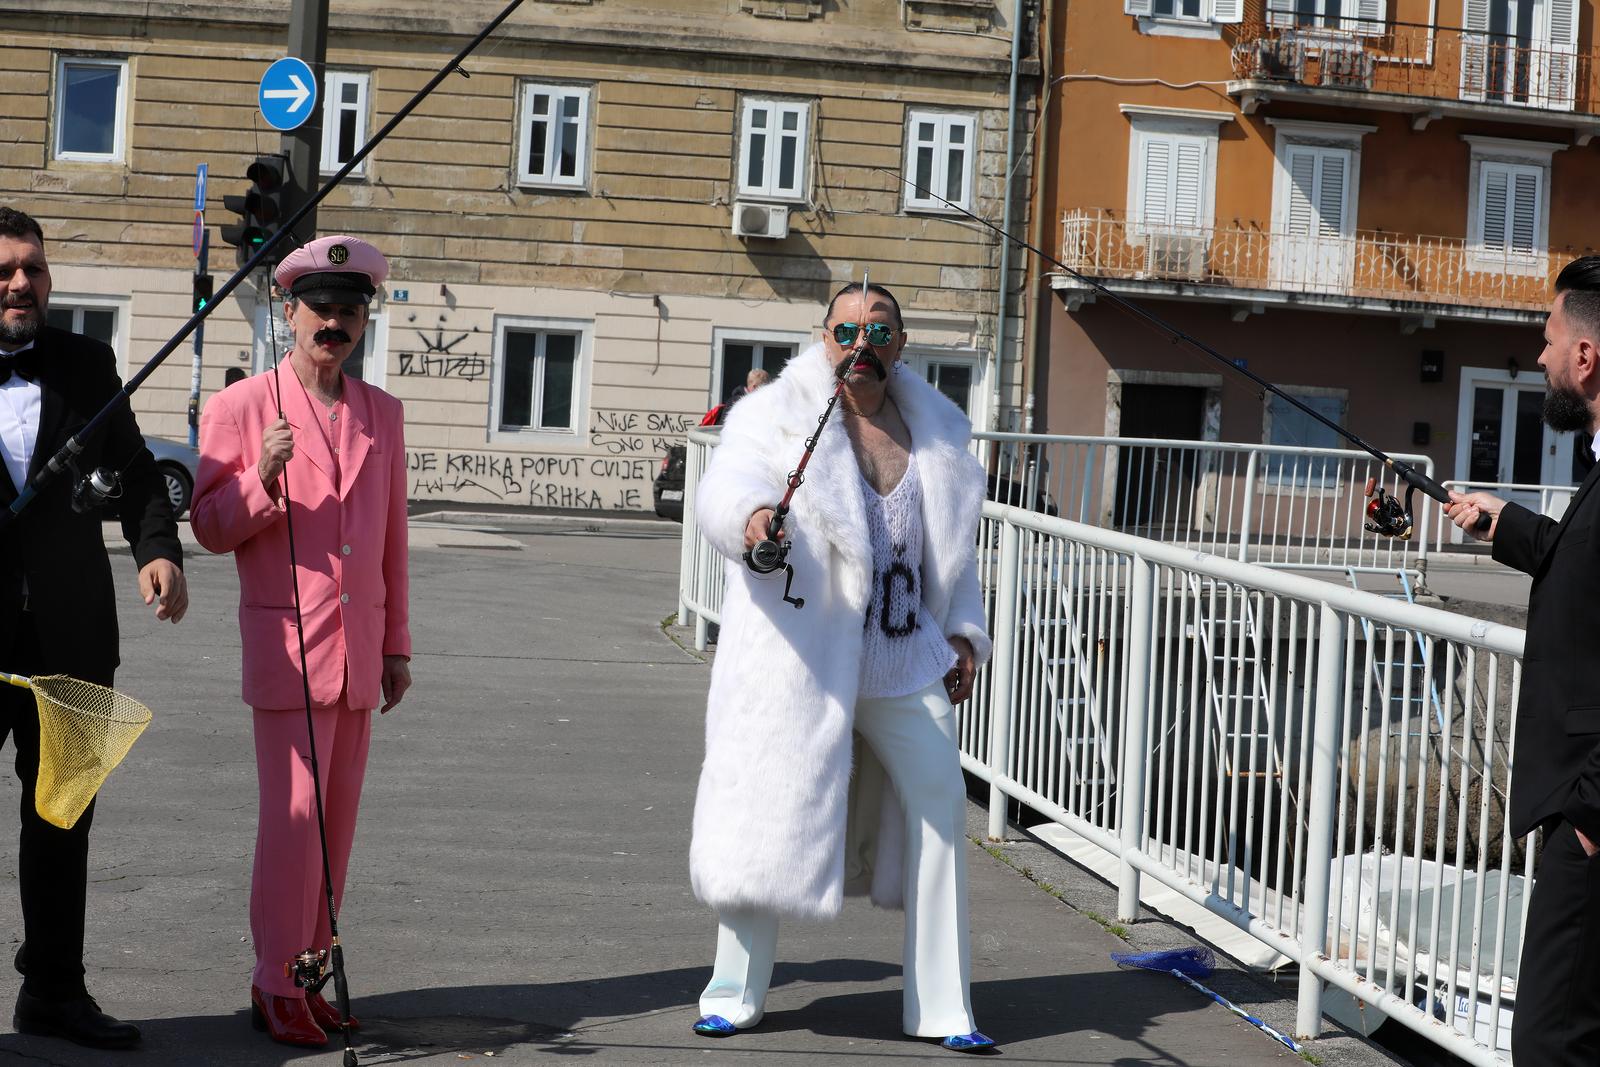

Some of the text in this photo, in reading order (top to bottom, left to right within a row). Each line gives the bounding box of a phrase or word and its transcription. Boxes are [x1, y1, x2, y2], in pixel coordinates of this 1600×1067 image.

[445, 453, 513, 478] KRHKA
[521, 457, 584, 478] POPUT
[529, 479, 602, 509] KRHKA
[614, 489, 641, 508] JE
